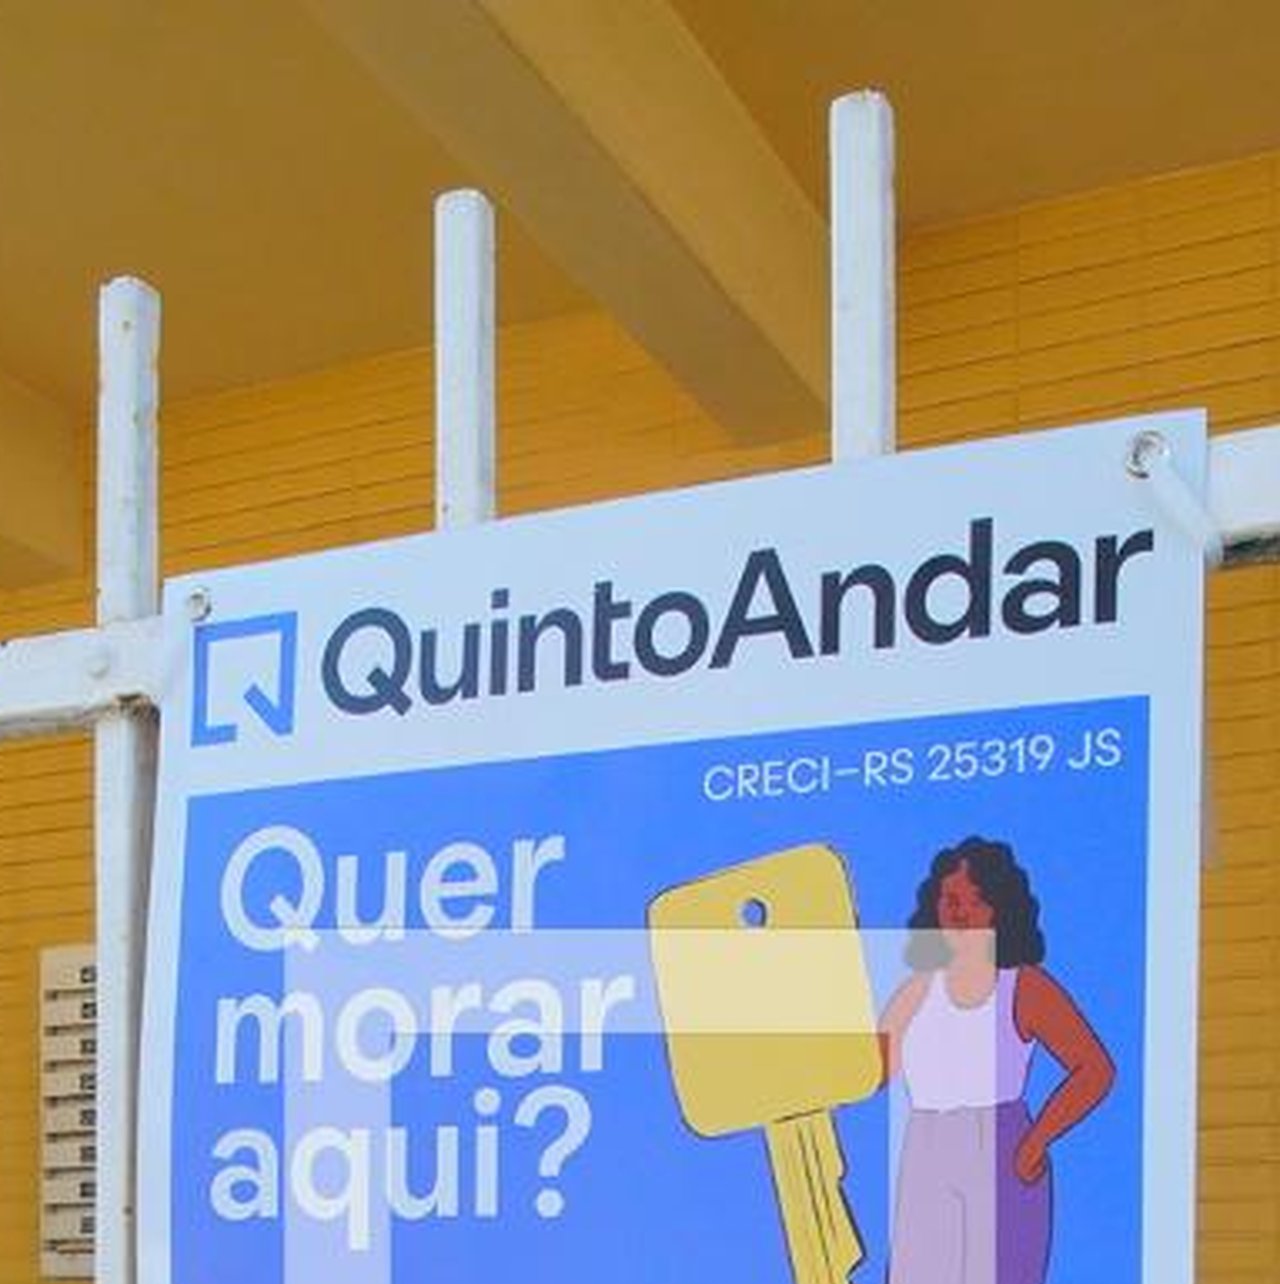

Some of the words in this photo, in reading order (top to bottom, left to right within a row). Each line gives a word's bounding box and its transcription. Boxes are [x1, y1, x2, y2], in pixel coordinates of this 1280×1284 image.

[320, 517, 1154, 716] QuintoAndar
[926, 735, 1055, 782] 25319
[1067, 728, 1122, 769] JS
[220, 824, 566, 953] Quer
[215, 975, 634, 1084] morar
[210, 1085, 592, 1250] aqui?
